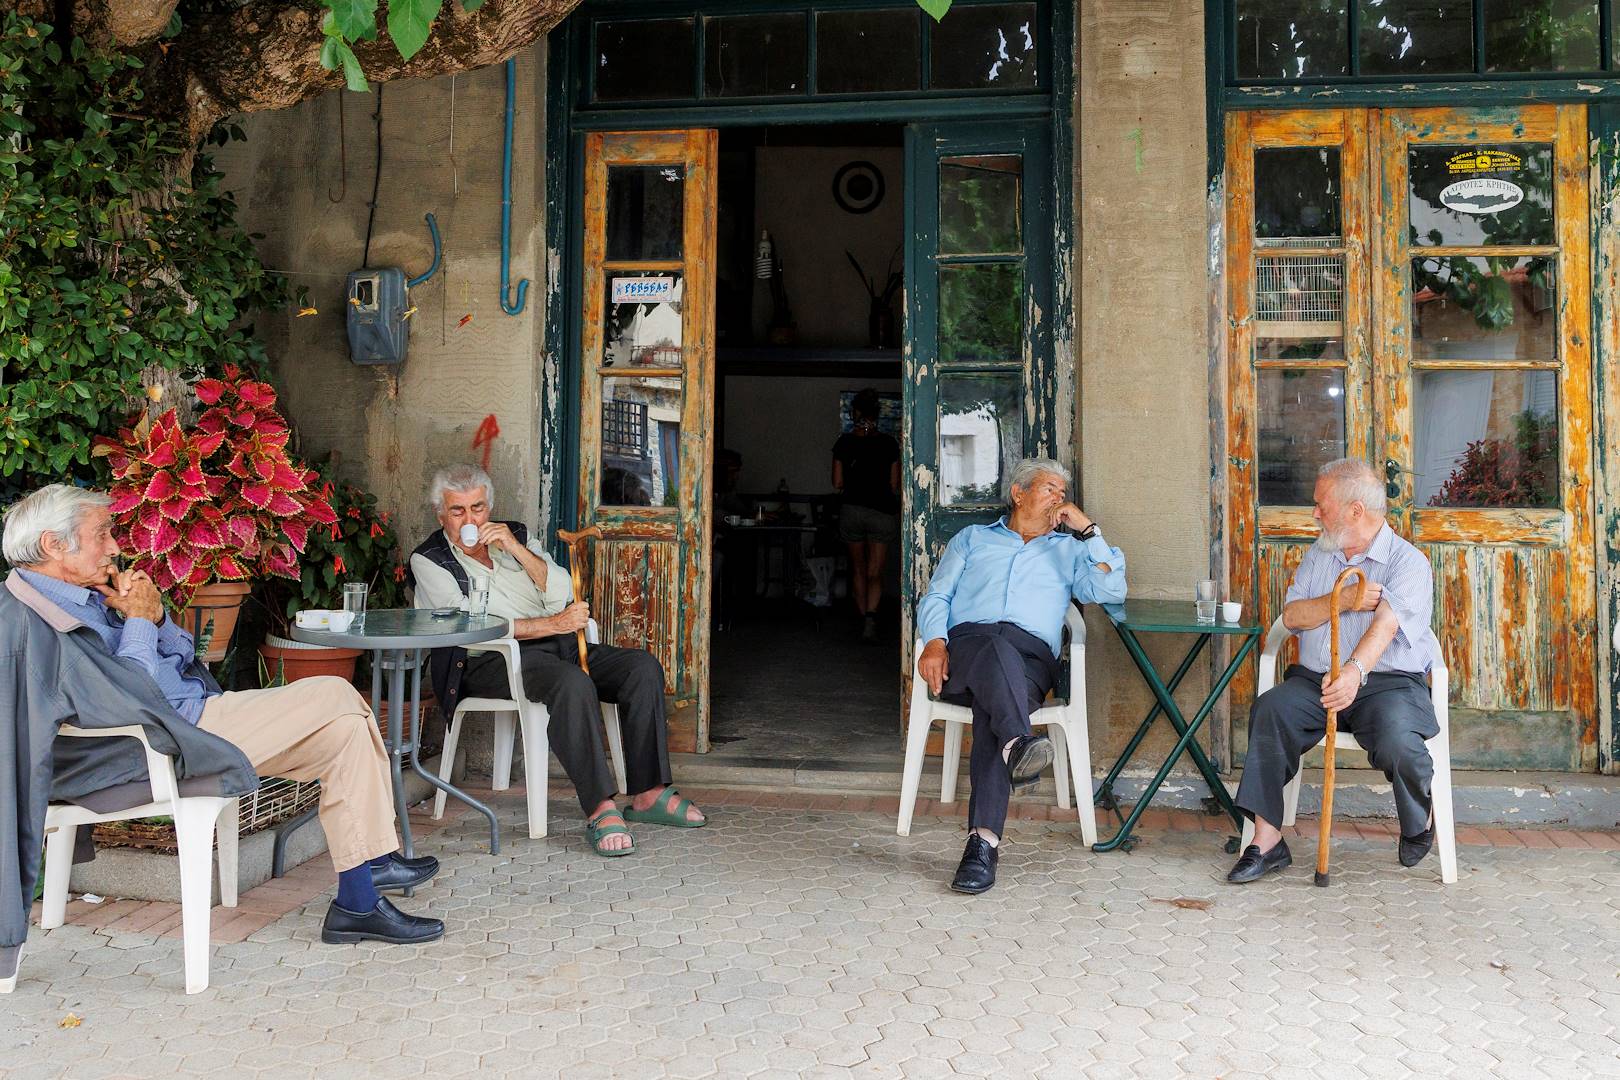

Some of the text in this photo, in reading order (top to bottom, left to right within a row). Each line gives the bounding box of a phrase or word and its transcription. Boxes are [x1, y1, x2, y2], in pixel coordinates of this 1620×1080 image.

[1450, 180, 1517, 193] ΑΓΡΟΤΕΣ ΚΡΗΤΗΣ
[625, 282, 669, 294] PERSEAS
